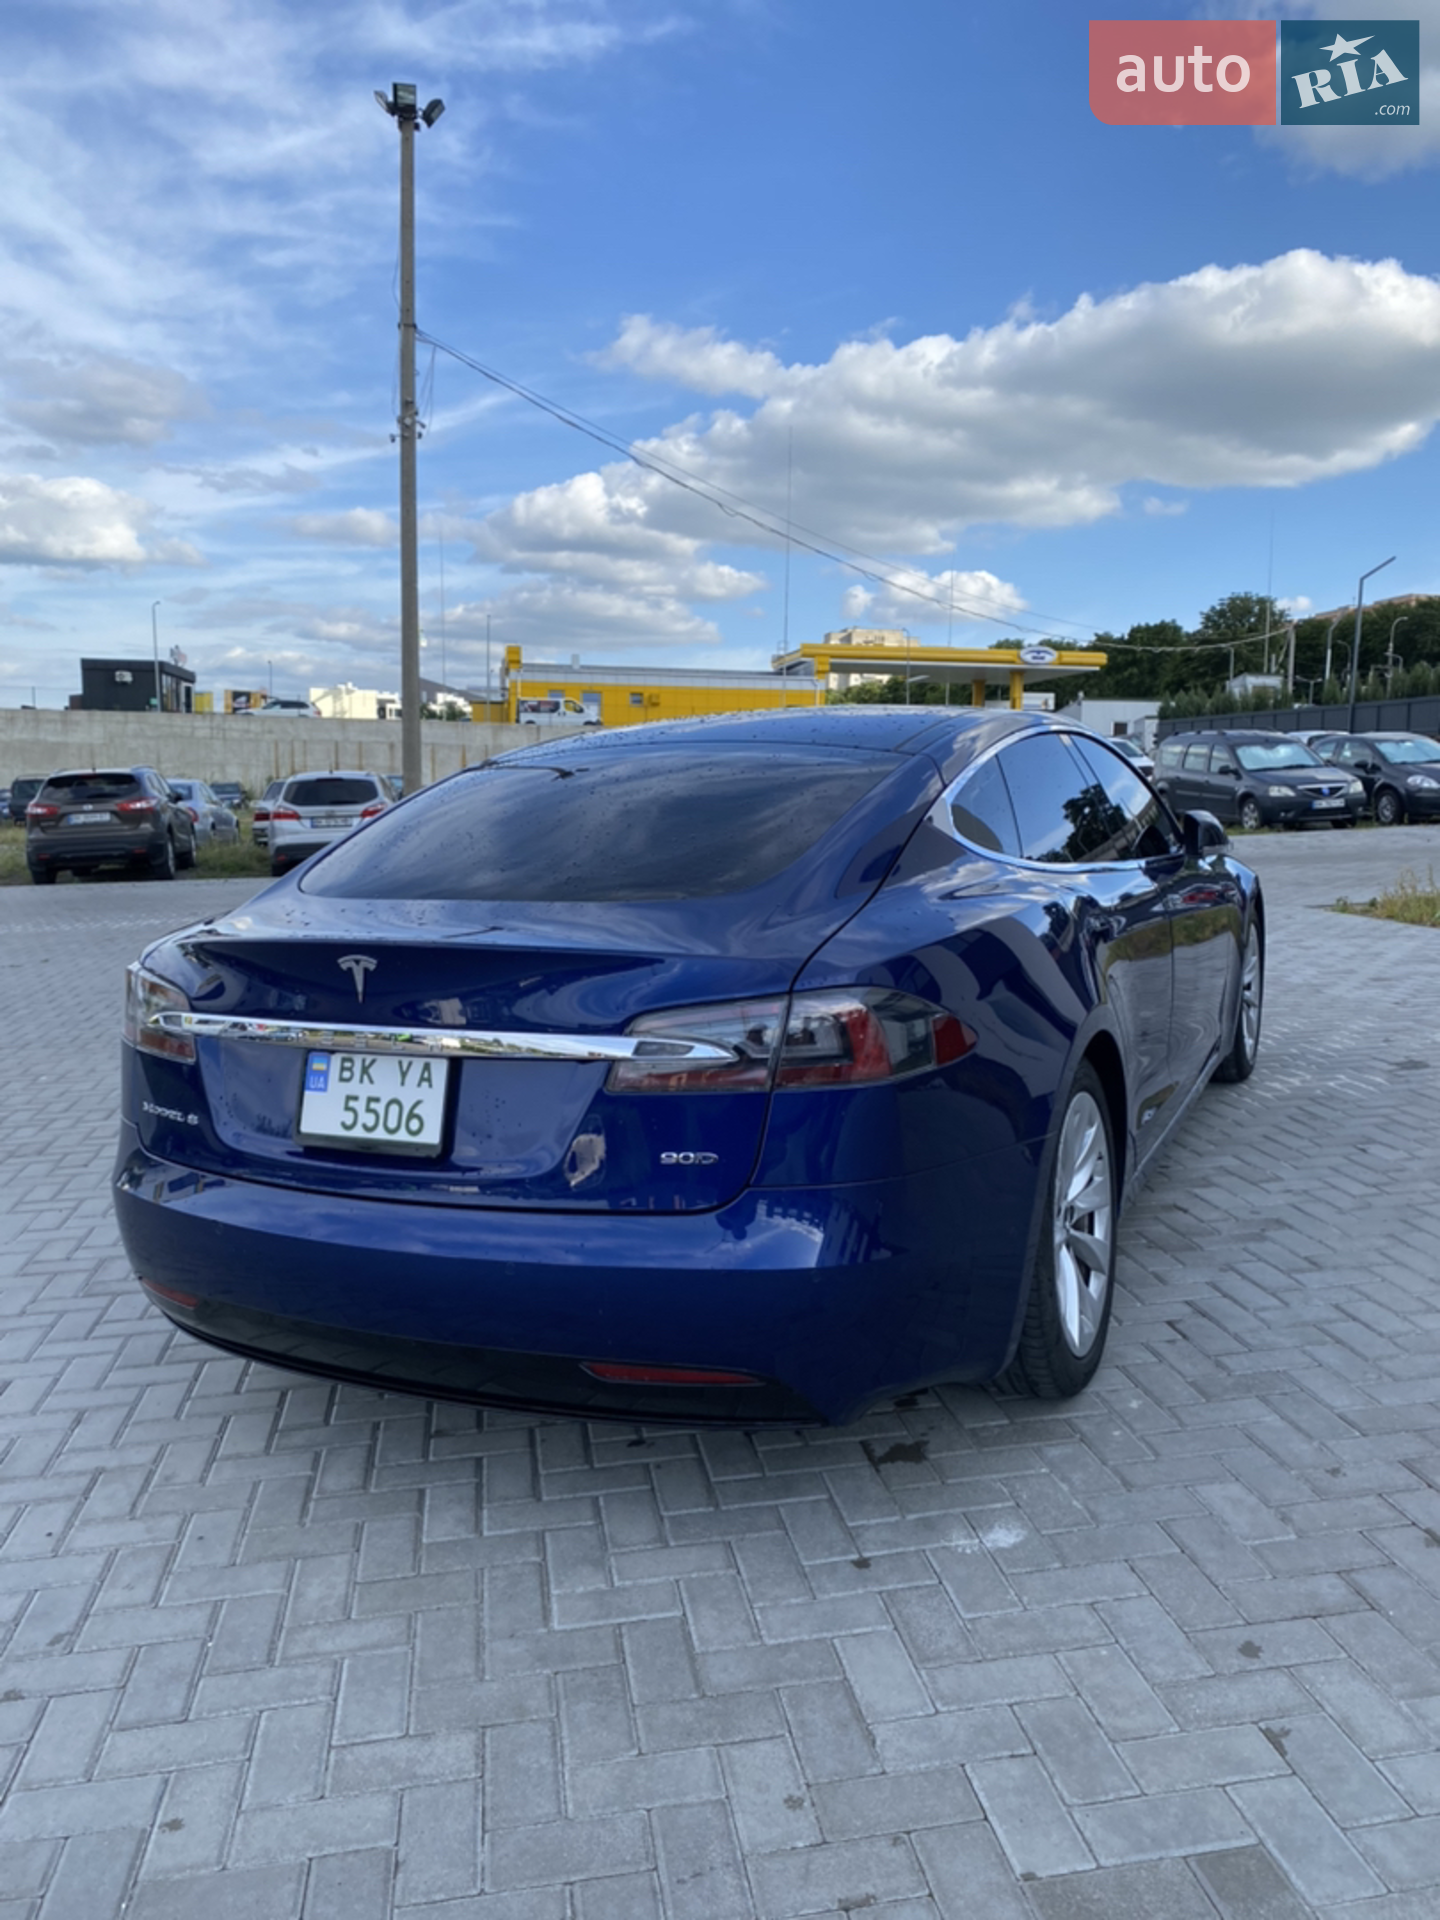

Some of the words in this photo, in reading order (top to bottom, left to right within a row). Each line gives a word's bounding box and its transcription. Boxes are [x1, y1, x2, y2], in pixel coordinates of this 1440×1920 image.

[310, 1076, 325, 1089] UA
[338, 1056, 377, 1085] BK
[398, 1059, 433, 1089] YA
[340, 1094, 425, 1137] 5506
